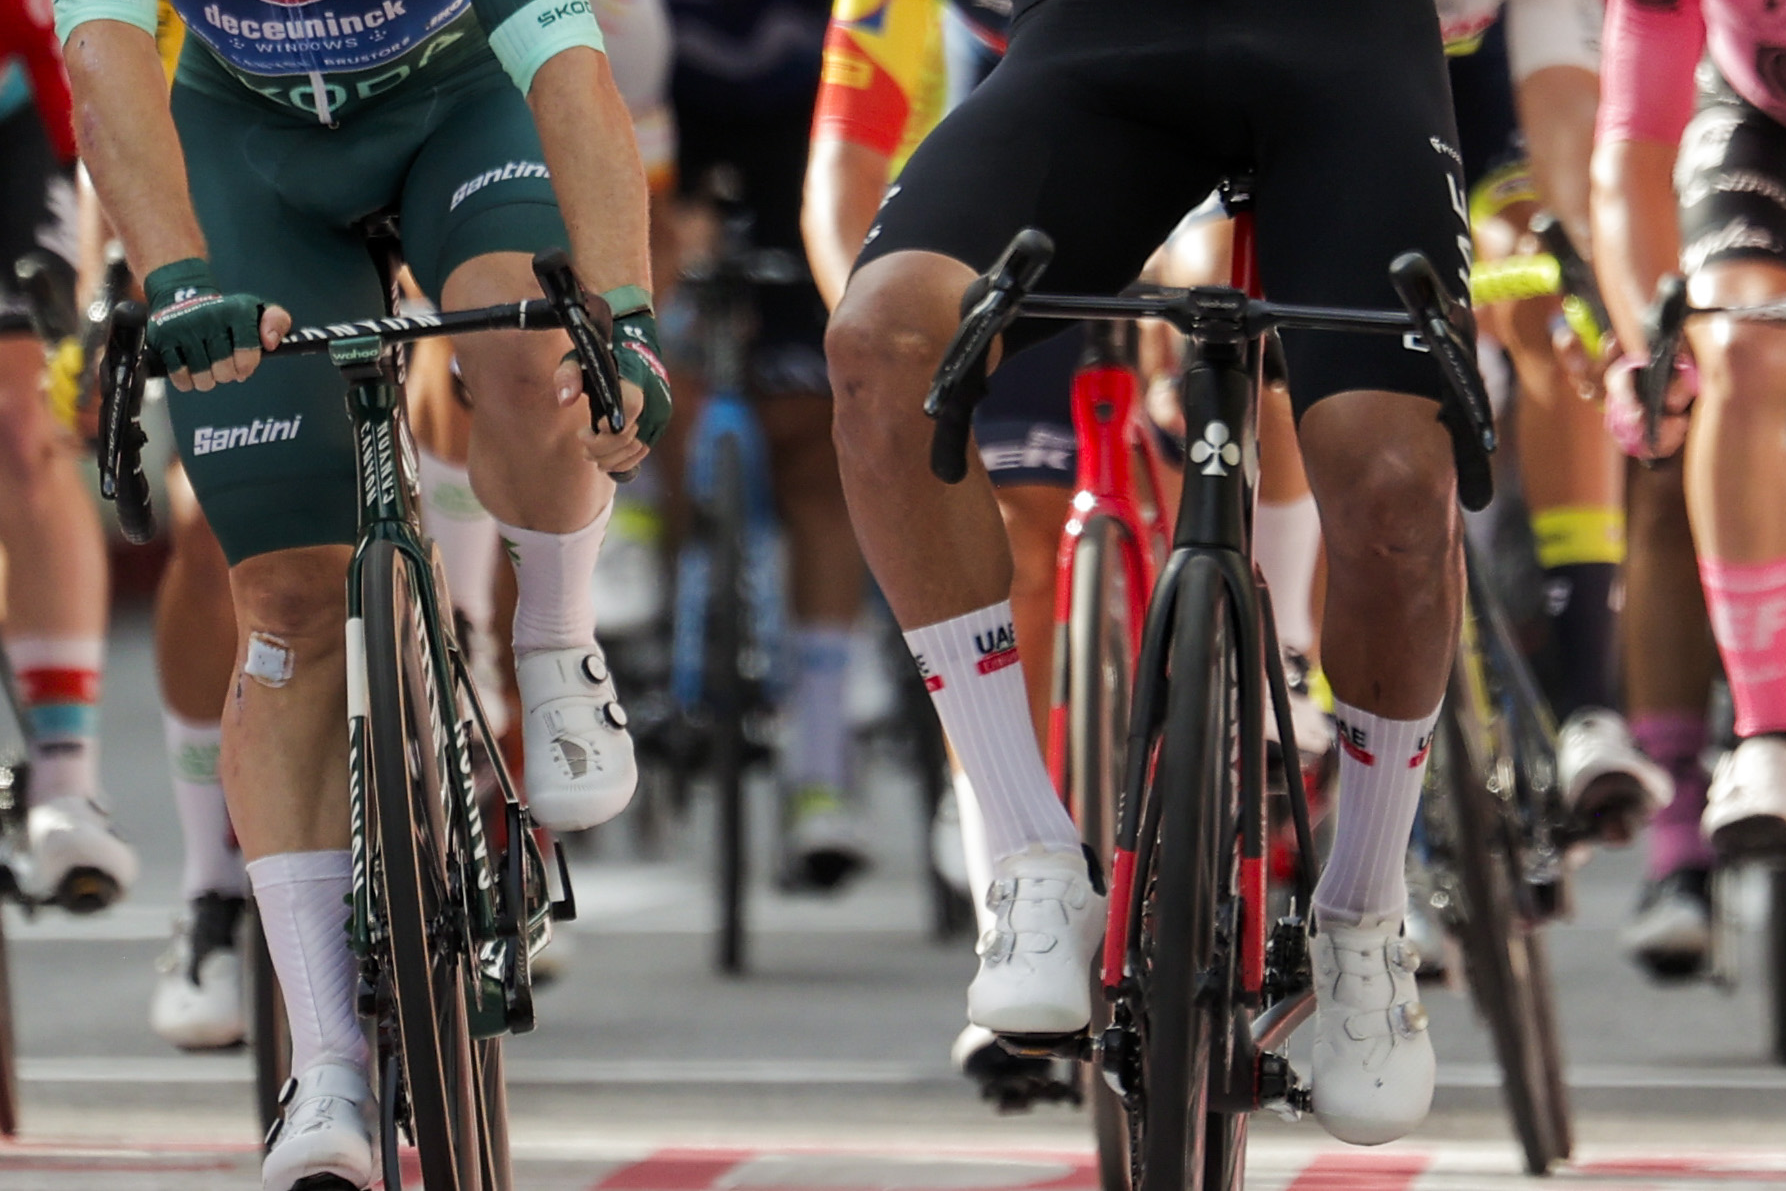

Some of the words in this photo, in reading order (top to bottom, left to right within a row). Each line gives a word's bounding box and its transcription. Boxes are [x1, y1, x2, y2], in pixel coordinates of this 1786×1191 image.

[255, 39, 359, 54] WINDOWS
[334, 348, 379, 361] wahoo
[193, 413, 303, 457] Santini
[360, 420, 378, 508] CANYON
[376, 420, 396, 504] CANYON
